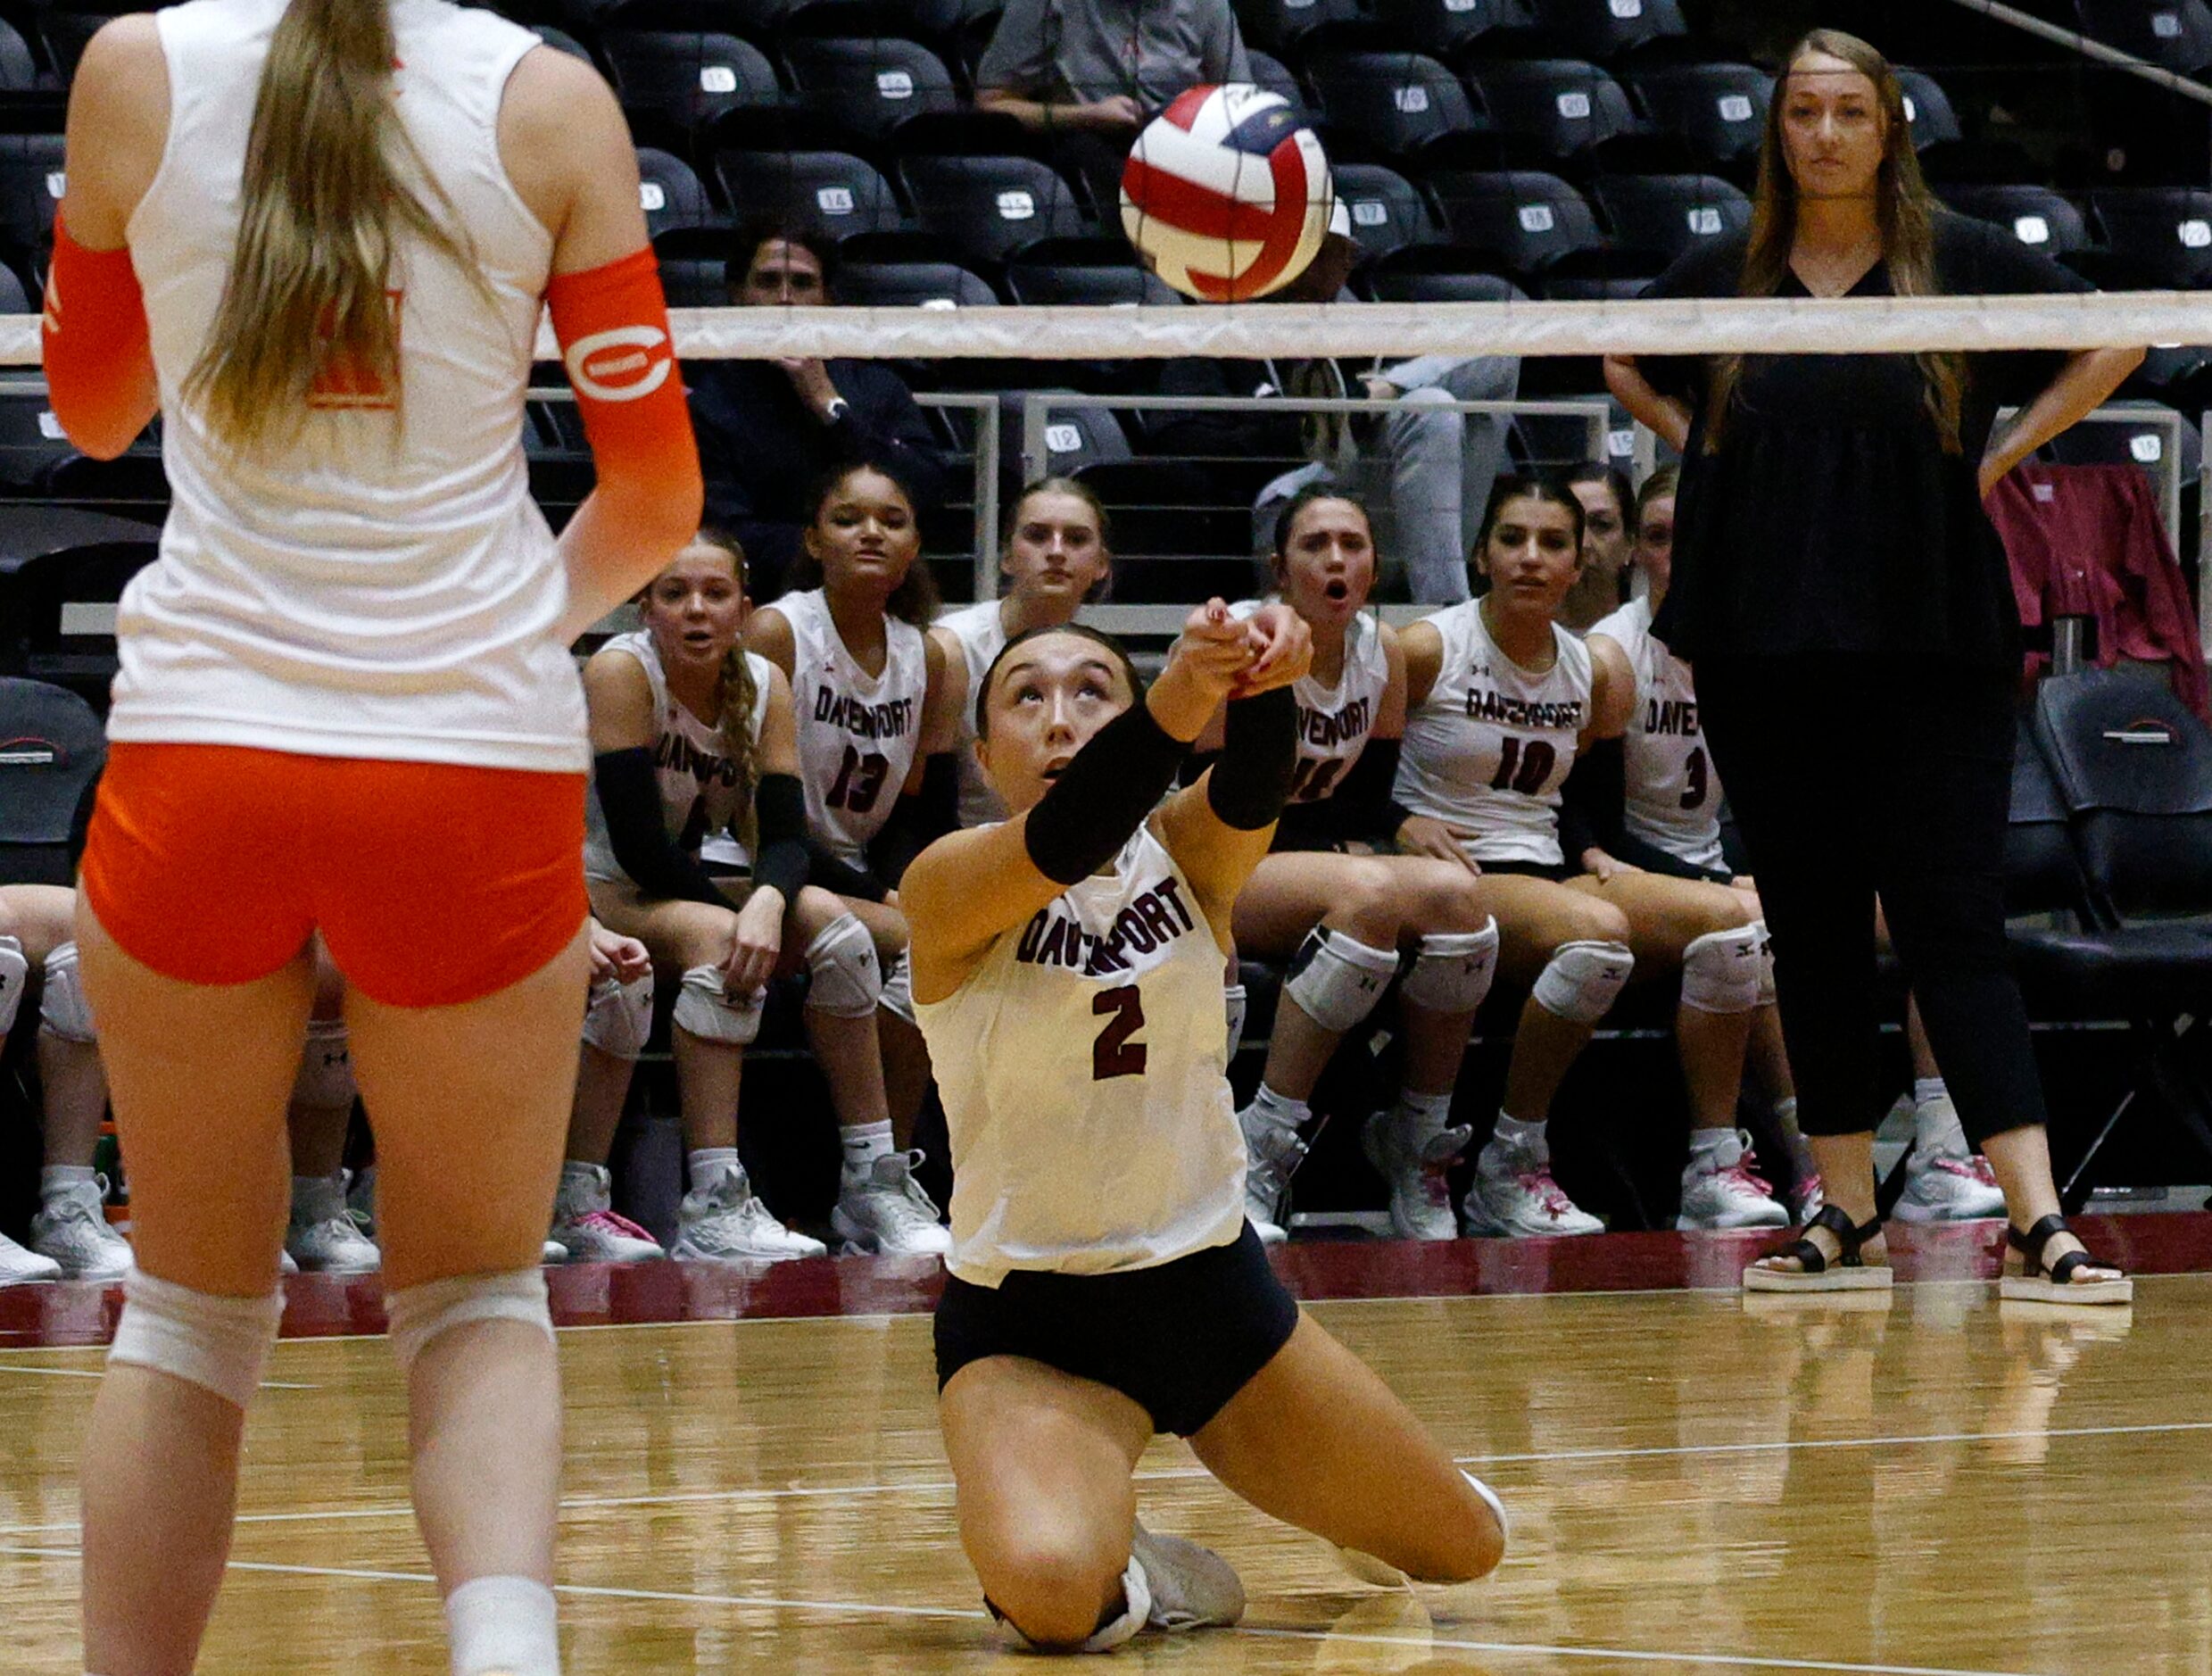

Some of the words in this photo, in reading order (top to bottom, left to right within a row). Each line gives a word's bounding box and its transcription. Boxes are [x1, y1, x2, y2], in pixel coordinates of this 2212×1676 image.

[1053, 429, 1079, 448] 12
[1297, 697, 1370, 747] VENORT
[825, 744, 890, 813] 13
[1490, 736, 1555, 795] 10
[1679, 747, 1707, 809] 3
[1093, 984, 1147, 1081] 2
